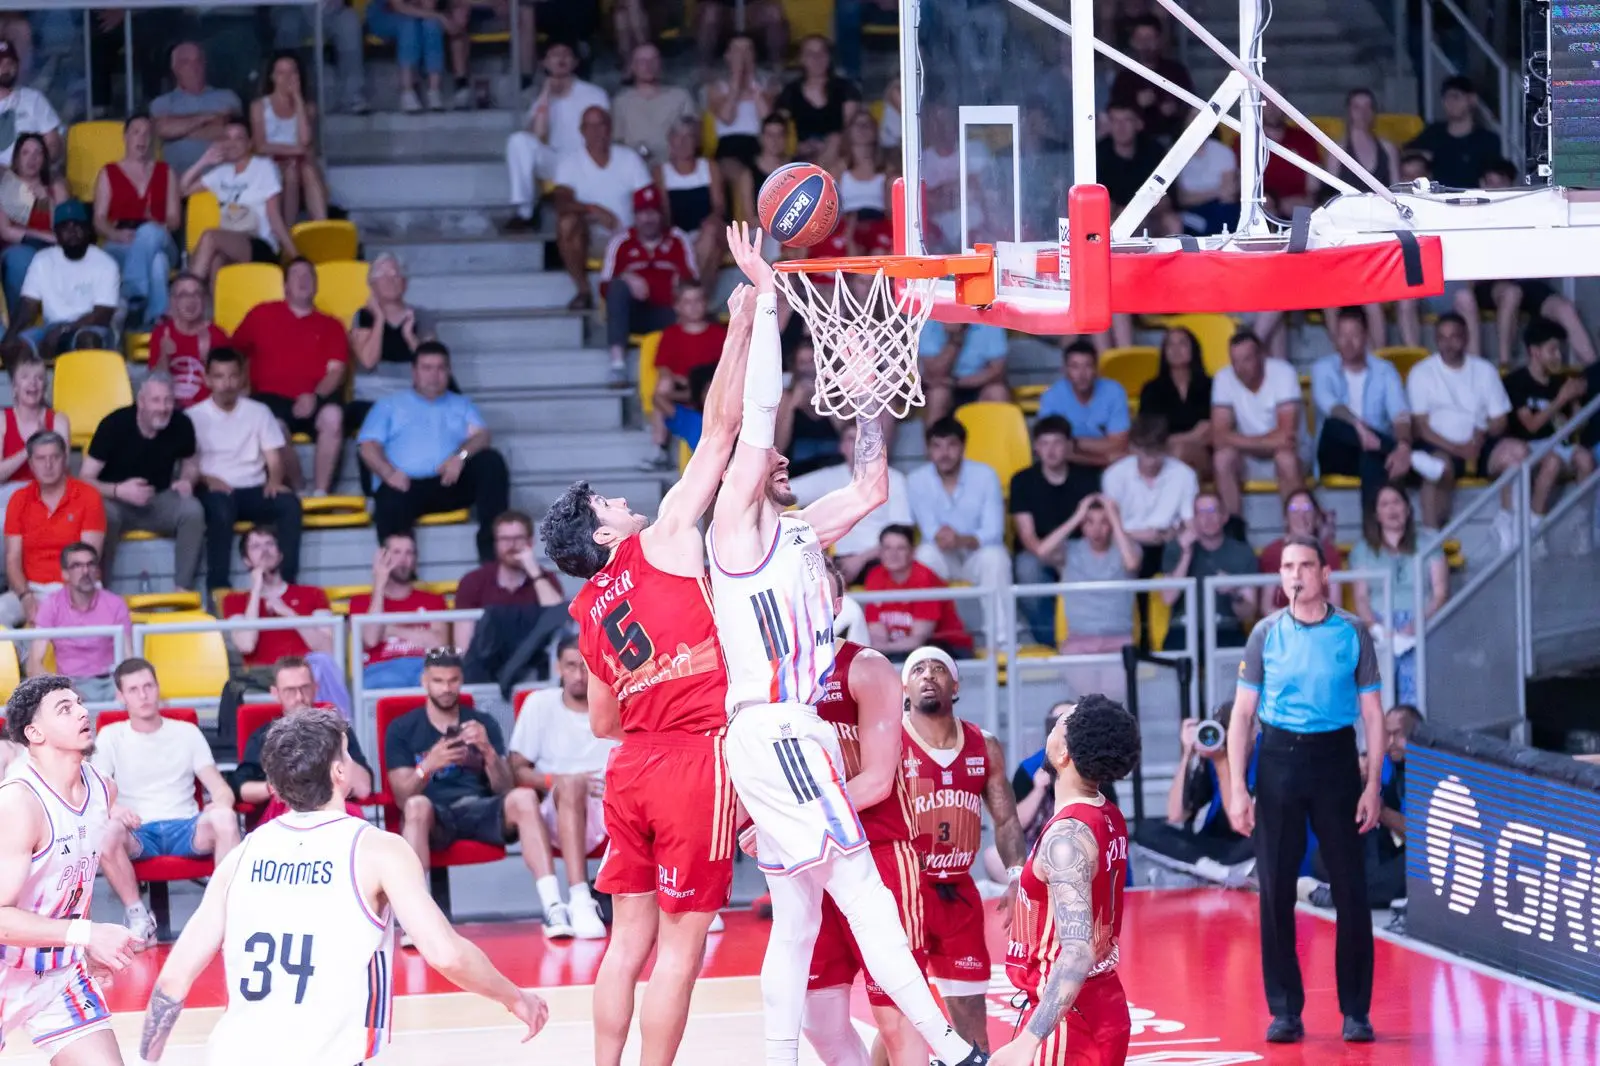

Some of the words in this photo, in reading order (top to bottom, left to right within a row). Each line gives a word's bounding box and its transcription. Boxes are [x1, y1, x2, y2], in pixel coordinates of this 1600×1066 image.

[780, 193, 810, 231] Betclic
[602, 599, 656, 672] 5
[915, 788, 982, 819] RASBOUR
[938, 822, 951, 841] 3
[251, 859, 334, 885] HOMMES
[658, 863, 678, 888] RH
[1493, 820, 1600, 953] GR
[239, 931, 316, 1005] 34
